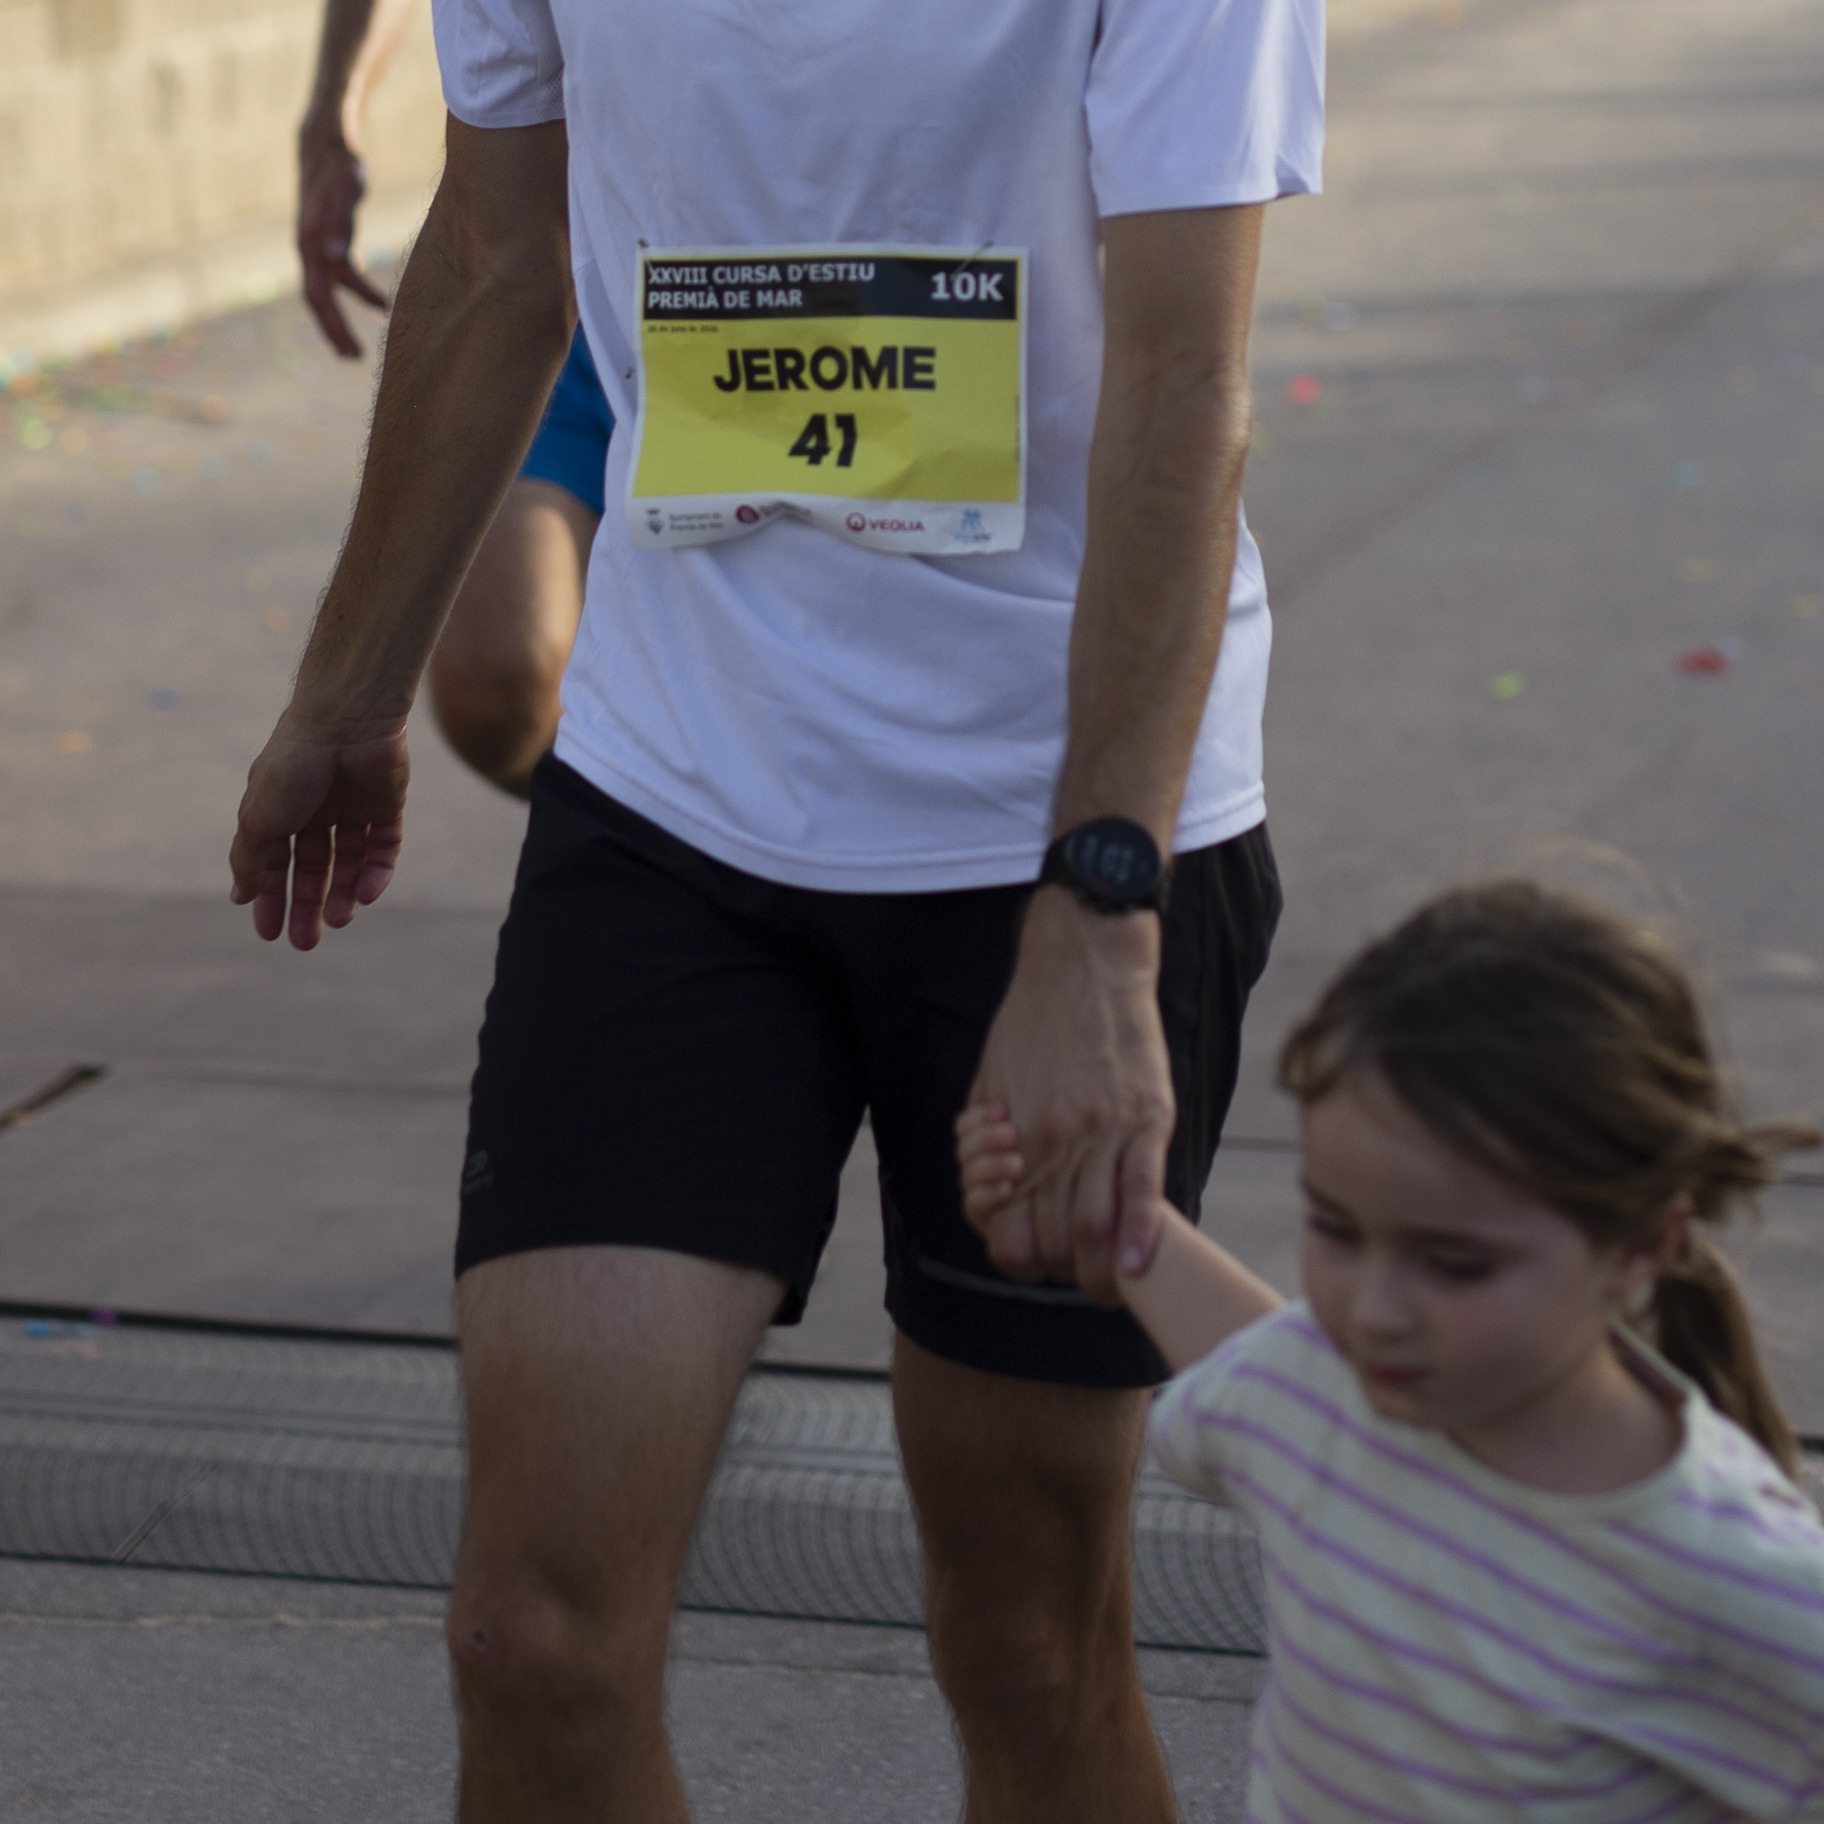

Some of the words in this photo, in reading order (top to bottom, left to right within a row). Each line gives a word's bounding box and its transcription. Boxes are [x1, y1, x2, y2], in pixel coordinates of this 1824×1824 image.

[647, 264, 709, 286] XXVIII
[712, 264, 780, 285] CURSA
[787, 261, 876, 284] D'ESTIU
[931, 271, 1004, 302] 10K
[647, 286, 720, 310] PREMIÀ
[723, 290, 752, 309] DE
[756, 288, 804, 309] MAR
[713, 345, 937, 393] JEROME
[788, 413, 859, 468] 41
[869, 518, 926, 533] VEOLIA
